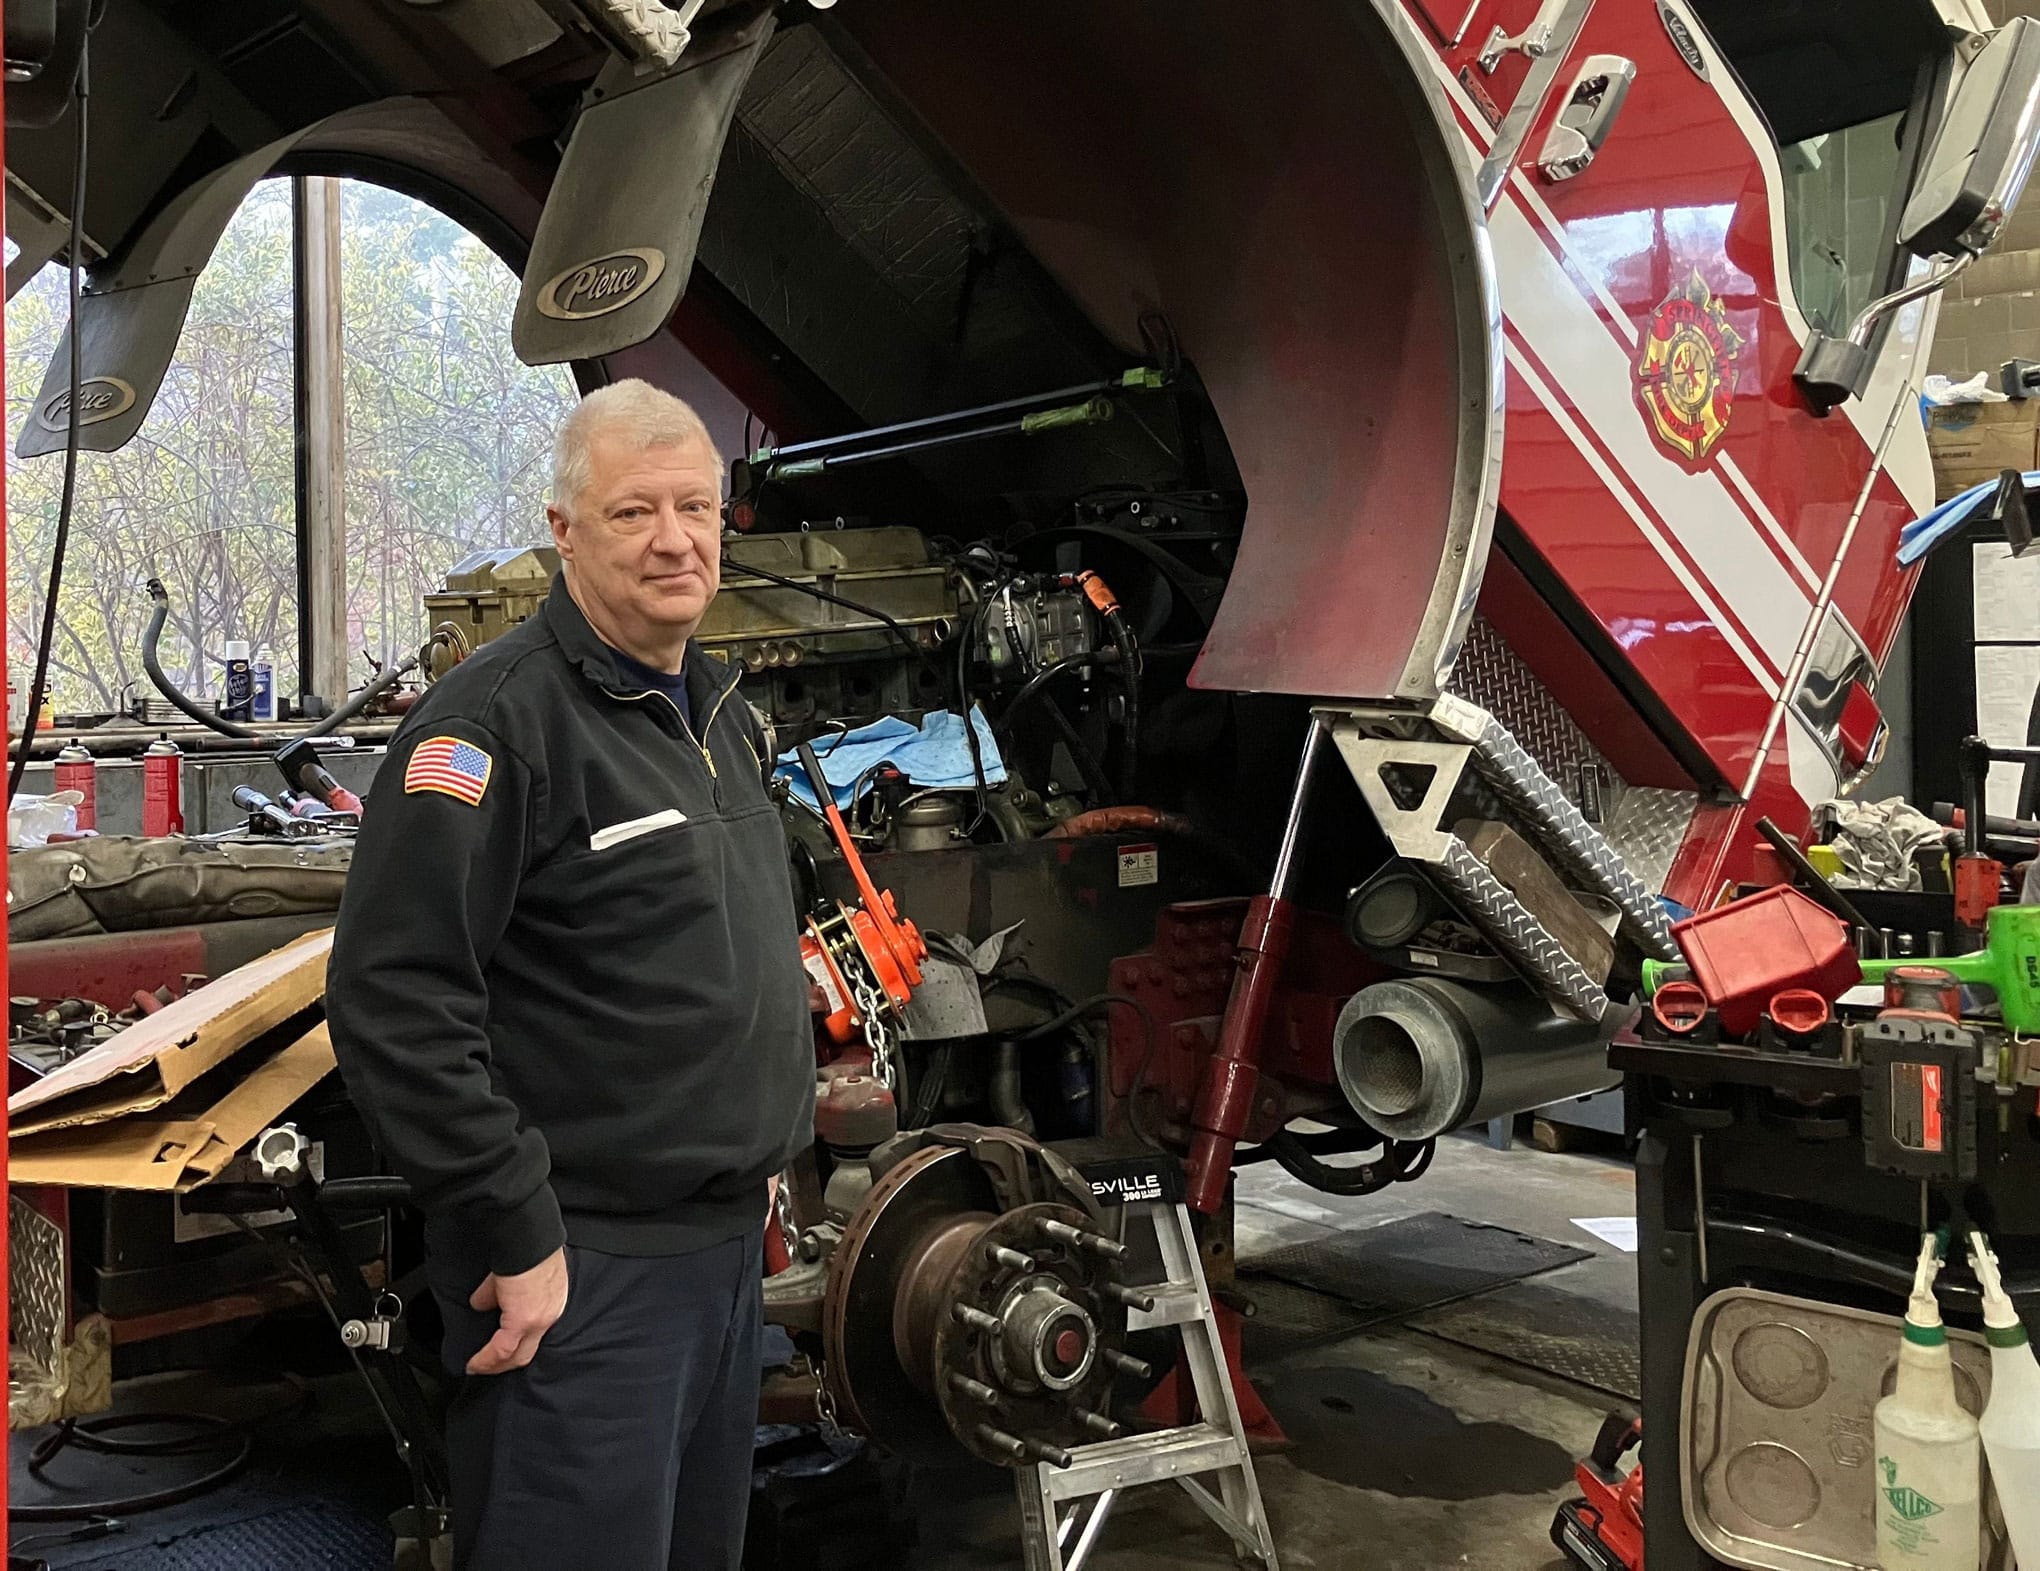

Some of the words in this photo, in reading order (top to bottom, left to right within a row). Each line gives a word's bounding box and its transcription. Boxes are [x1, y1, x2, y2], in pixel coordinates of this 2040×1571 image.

[563, 265, 638, 310] Pierce
[1087, 1175, 1160, 1195] SVILLE
[1123, 1191, 1141, 1201] 300
